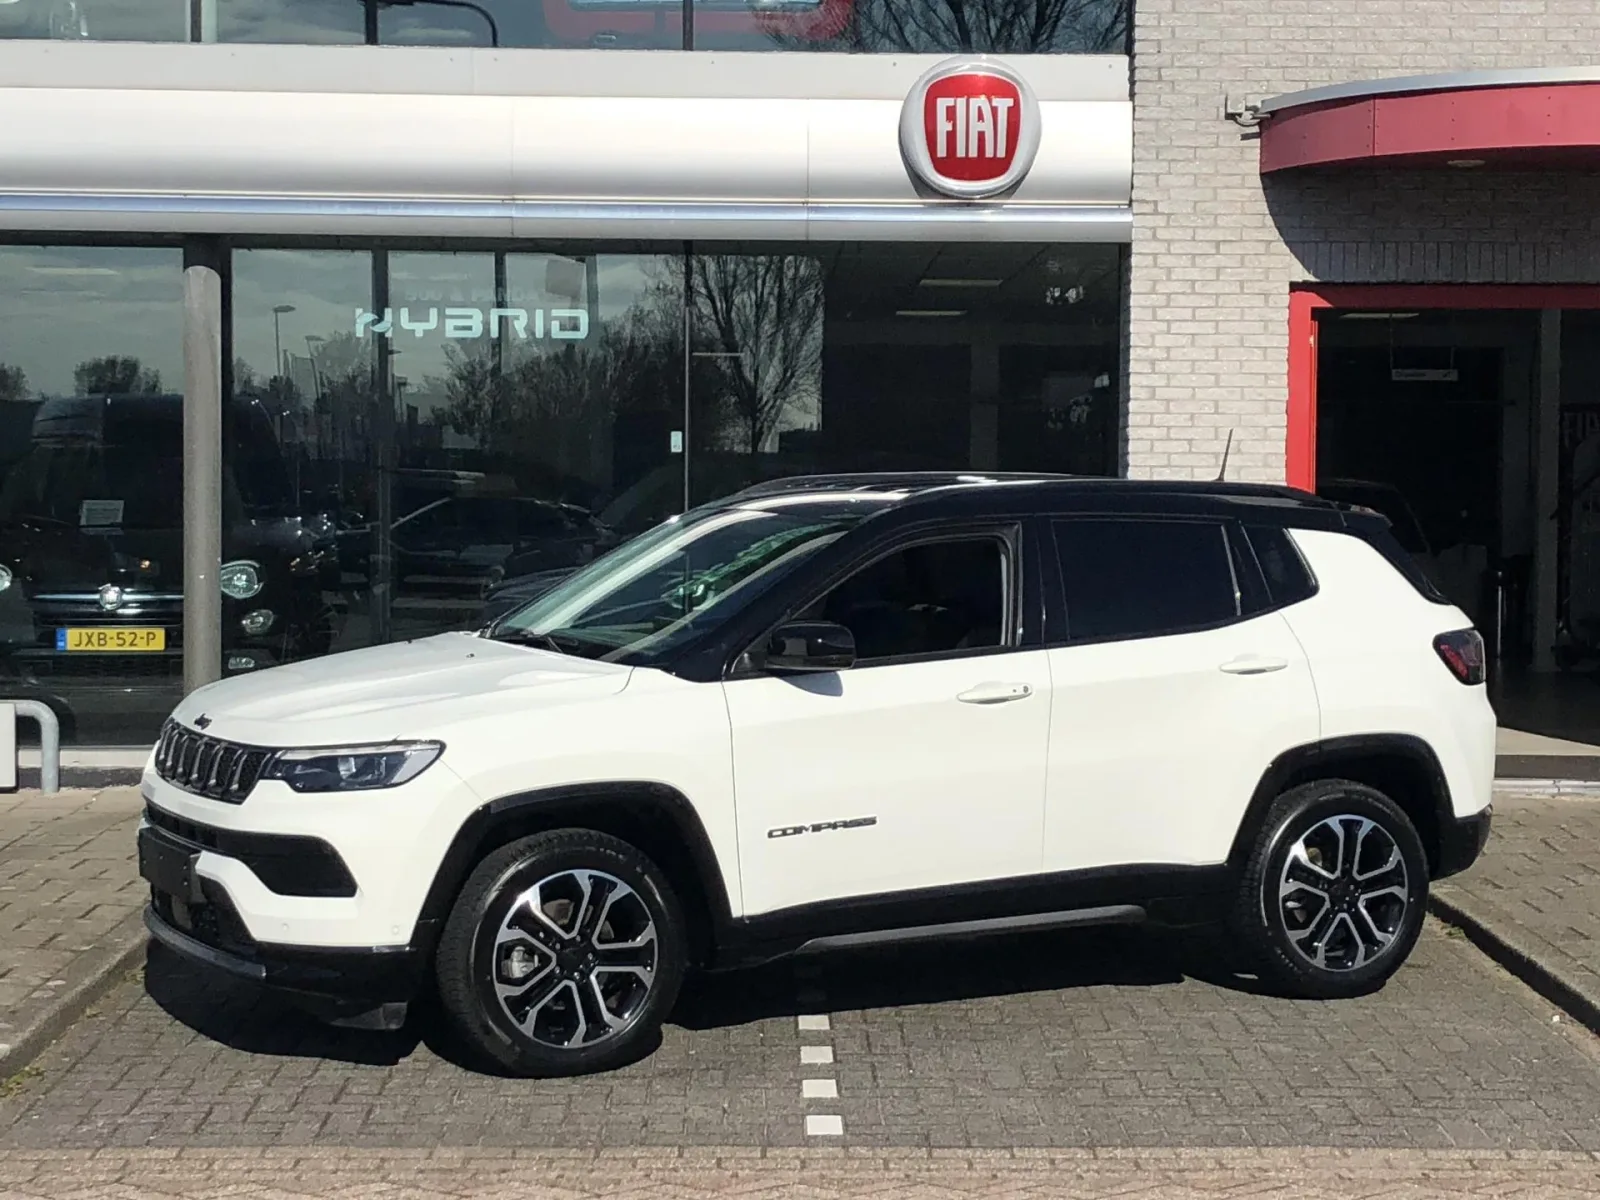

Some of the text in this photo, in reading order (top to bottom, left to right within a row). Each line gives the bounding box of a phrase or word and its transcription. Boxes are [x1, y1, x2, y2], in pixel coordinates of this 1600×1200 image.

[936, 97, 1014, 158] FIAT
[355, 307, 589, 339] HYBRID
[74, 632, 156, 647] JXB-52-P
